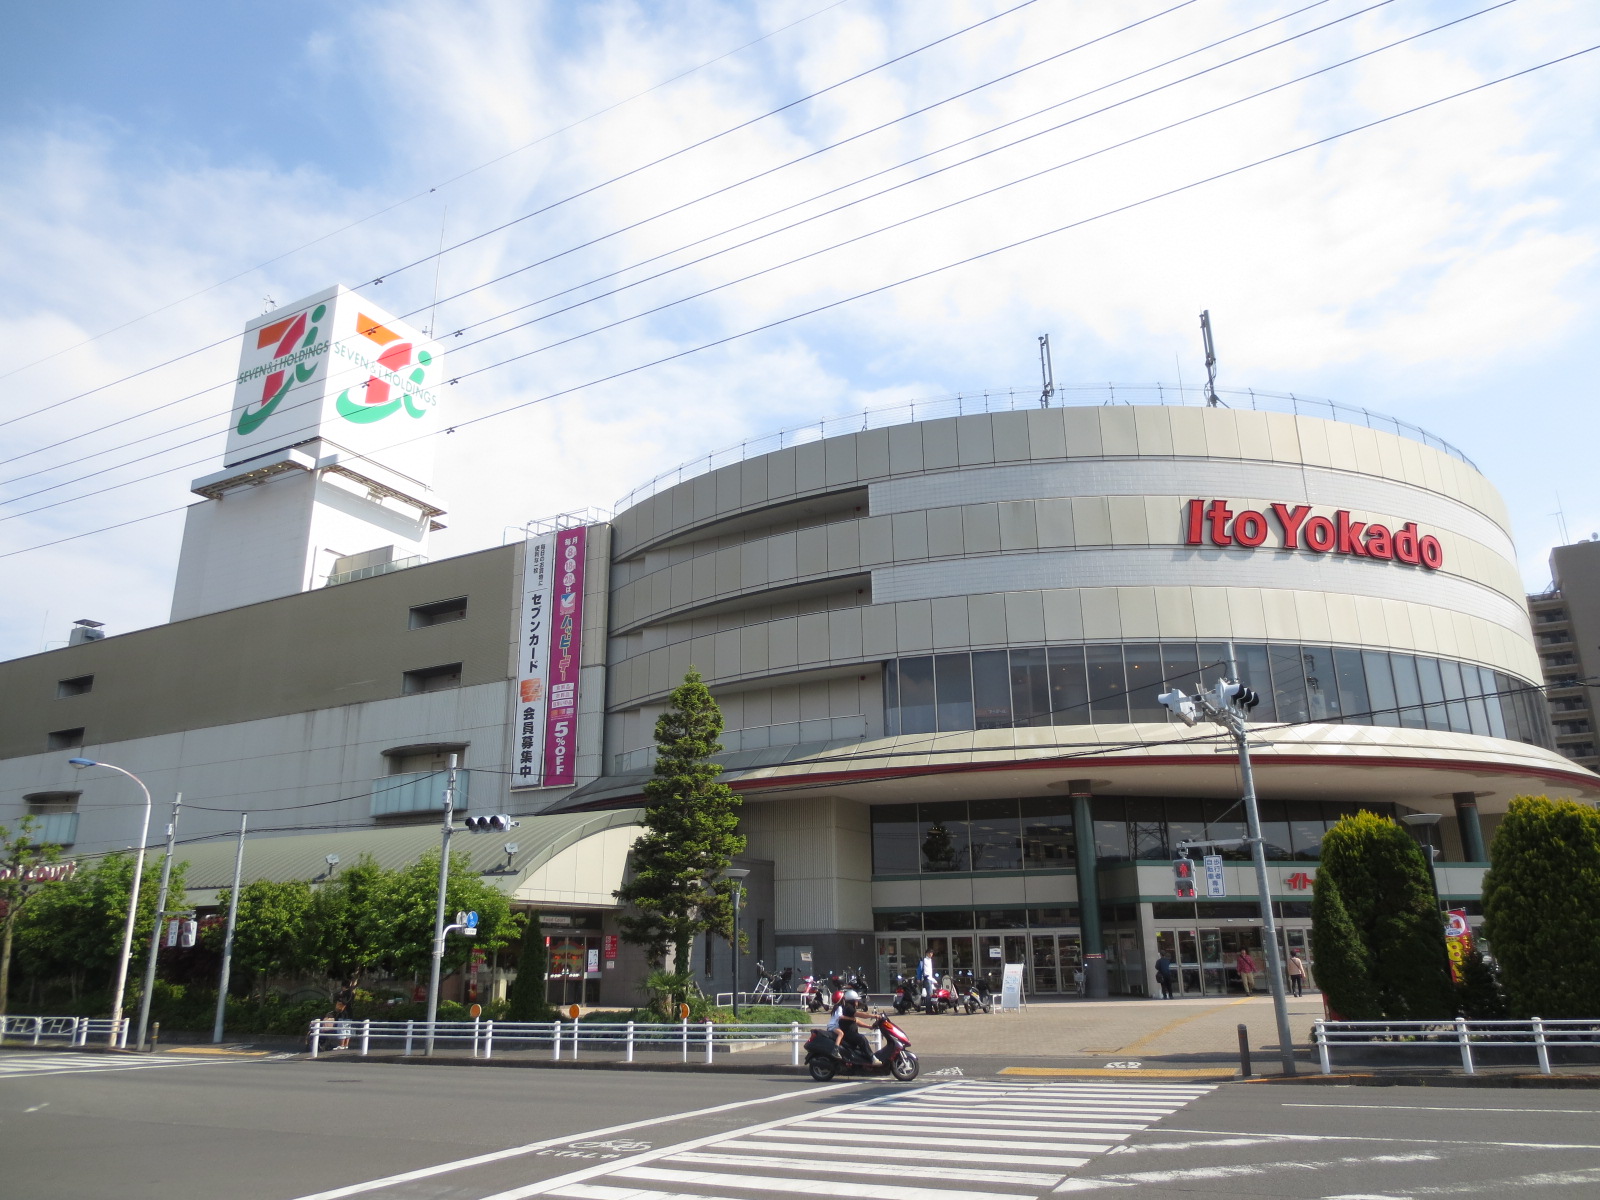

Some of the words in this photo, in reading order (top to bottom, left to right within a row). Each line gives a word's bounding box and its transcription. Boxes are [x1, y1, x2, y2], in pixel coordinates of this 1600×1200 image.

[279, 340, 330, 370] HOLDINGS
[385, 372, 437, 407] HOLDINGS
[529, 594, 543, 674] セブンカード
[519, 706, 535, 778] 会員募集中
